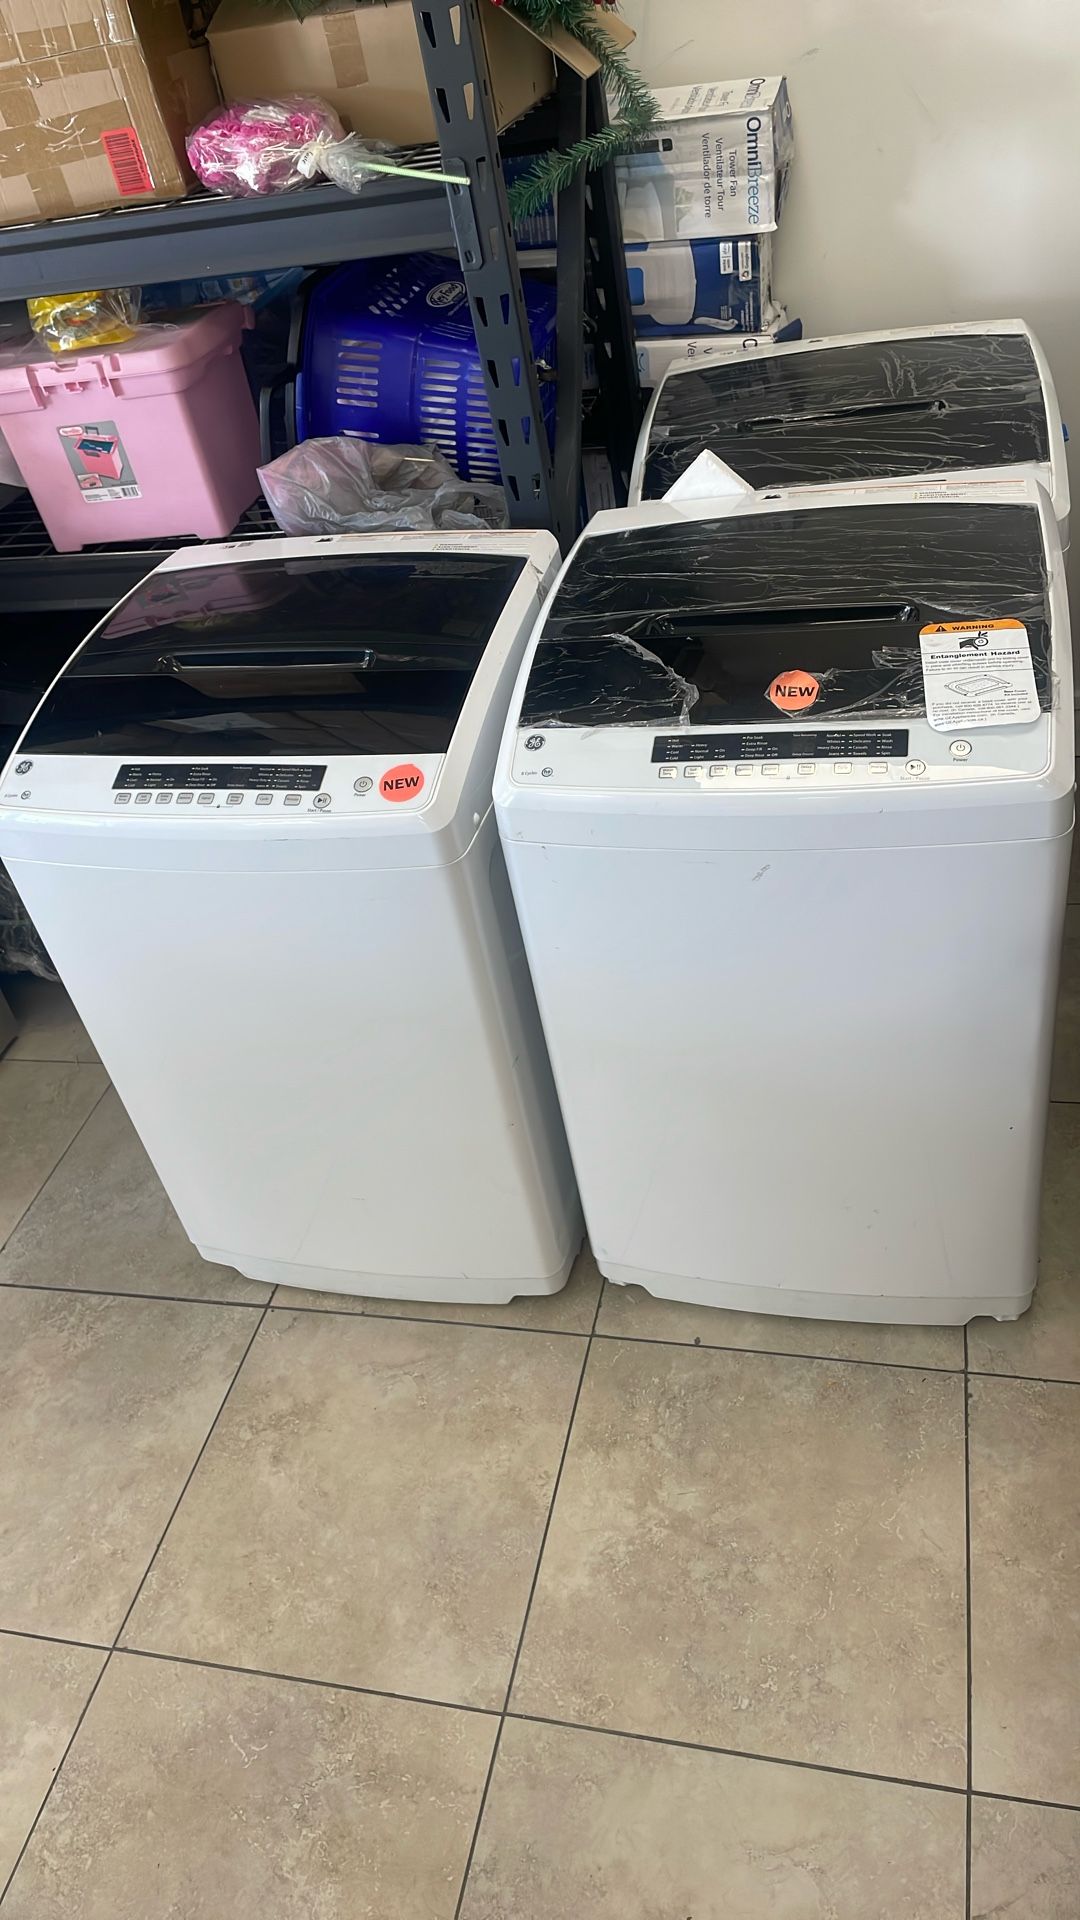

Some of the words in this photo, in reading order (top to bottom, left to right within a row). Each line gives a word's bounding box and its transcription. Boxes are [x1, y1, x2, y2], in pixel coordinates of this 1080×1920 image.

[702, 133, 711, 180] Ventilador
[715, 137, 725, 188] Ventilateur
[729, 150, 737, 178] Tower
[746, 117, 762, 225] OmniBreeze
[703, 182, 712, 194] de
[730, 180, 738, 197] Fan
[717, 190, 725, 211] Tour
[930, 652, 987, 660] Entanglement
[775, 684, 815, 697] NEW
[383, 775, 420, 791] NEW
